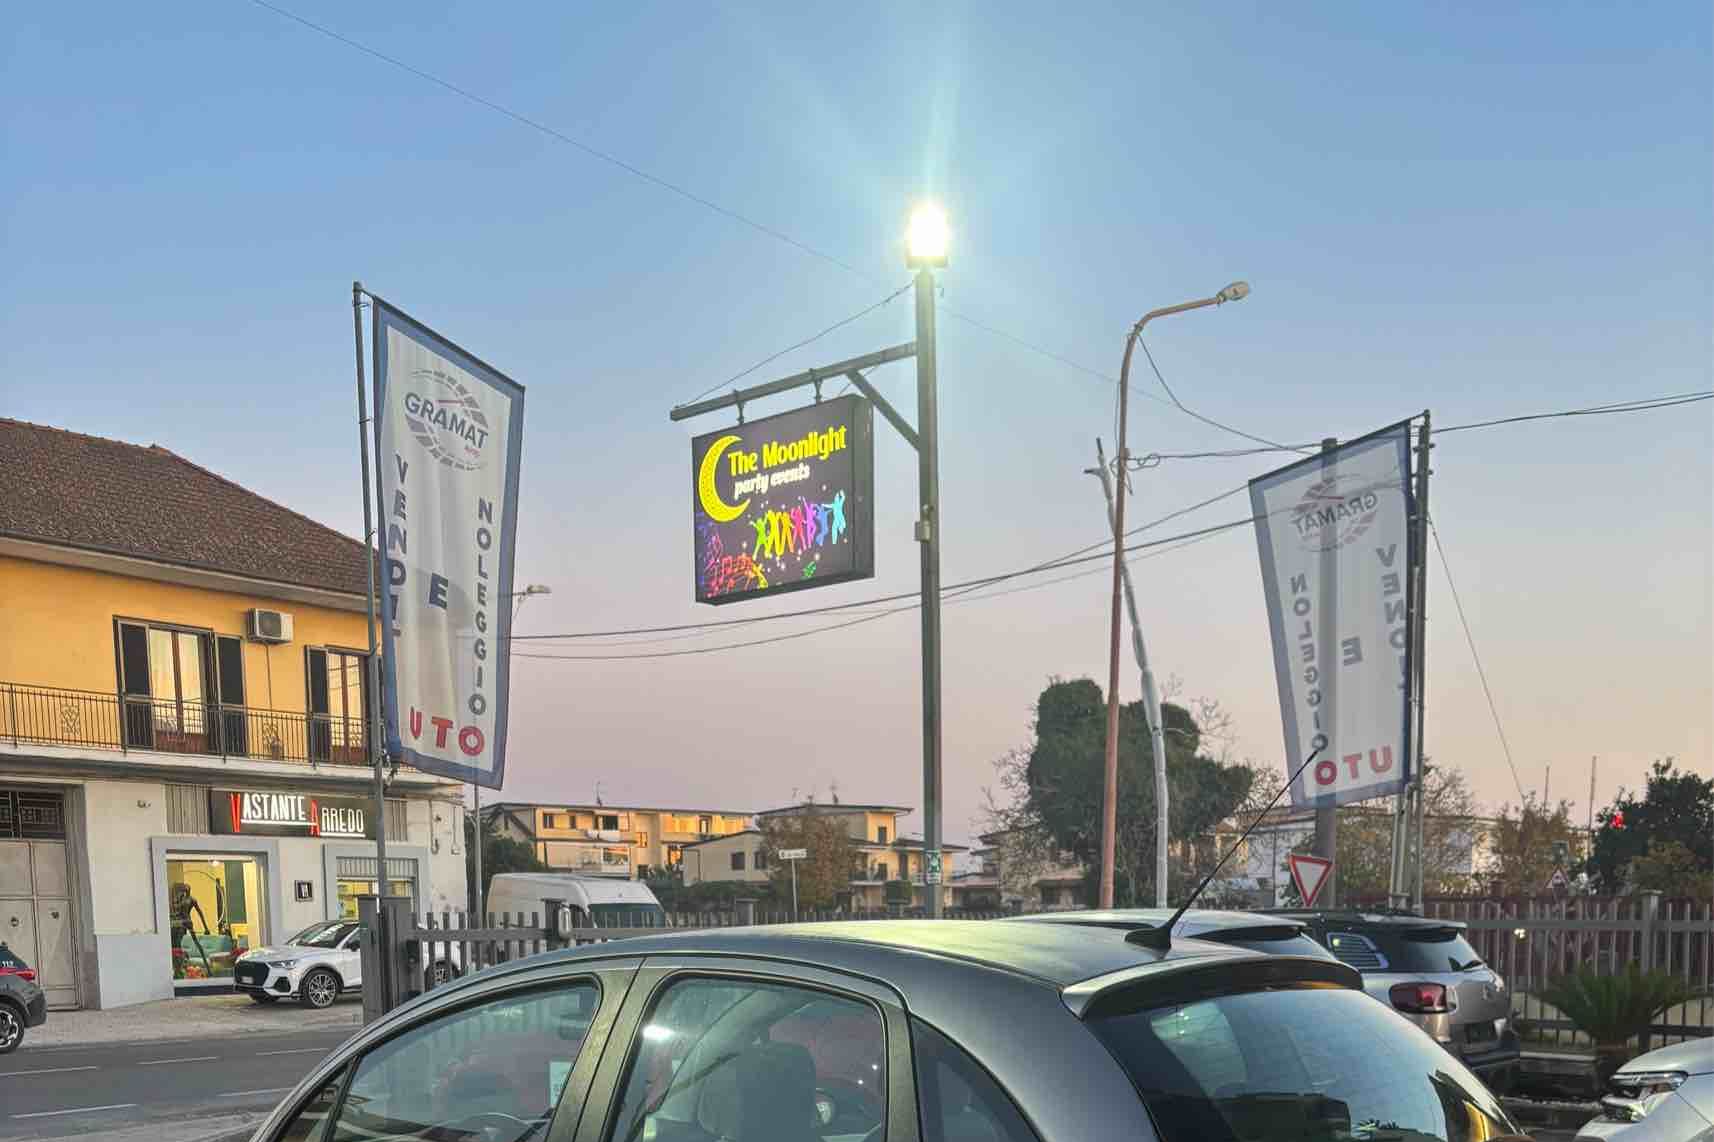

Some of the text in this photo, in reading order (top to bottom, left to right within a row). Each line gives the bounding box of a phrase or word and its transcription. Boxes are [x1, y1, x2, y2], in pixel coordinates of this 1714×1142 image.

[404, 391, 489, 449] GRAMAT
[728, 425, 847, 476] The Moonlight
[734, 462, 811, 500] party events
[388, 453, 409, 636] VENDI
[429, 573, 448, 610] E
[468, 497, 493, 716] NOLEGGIO
[409, 706, 485, 757] UTO
[230, 793, 364, 836] VASTANTE ARREDO
